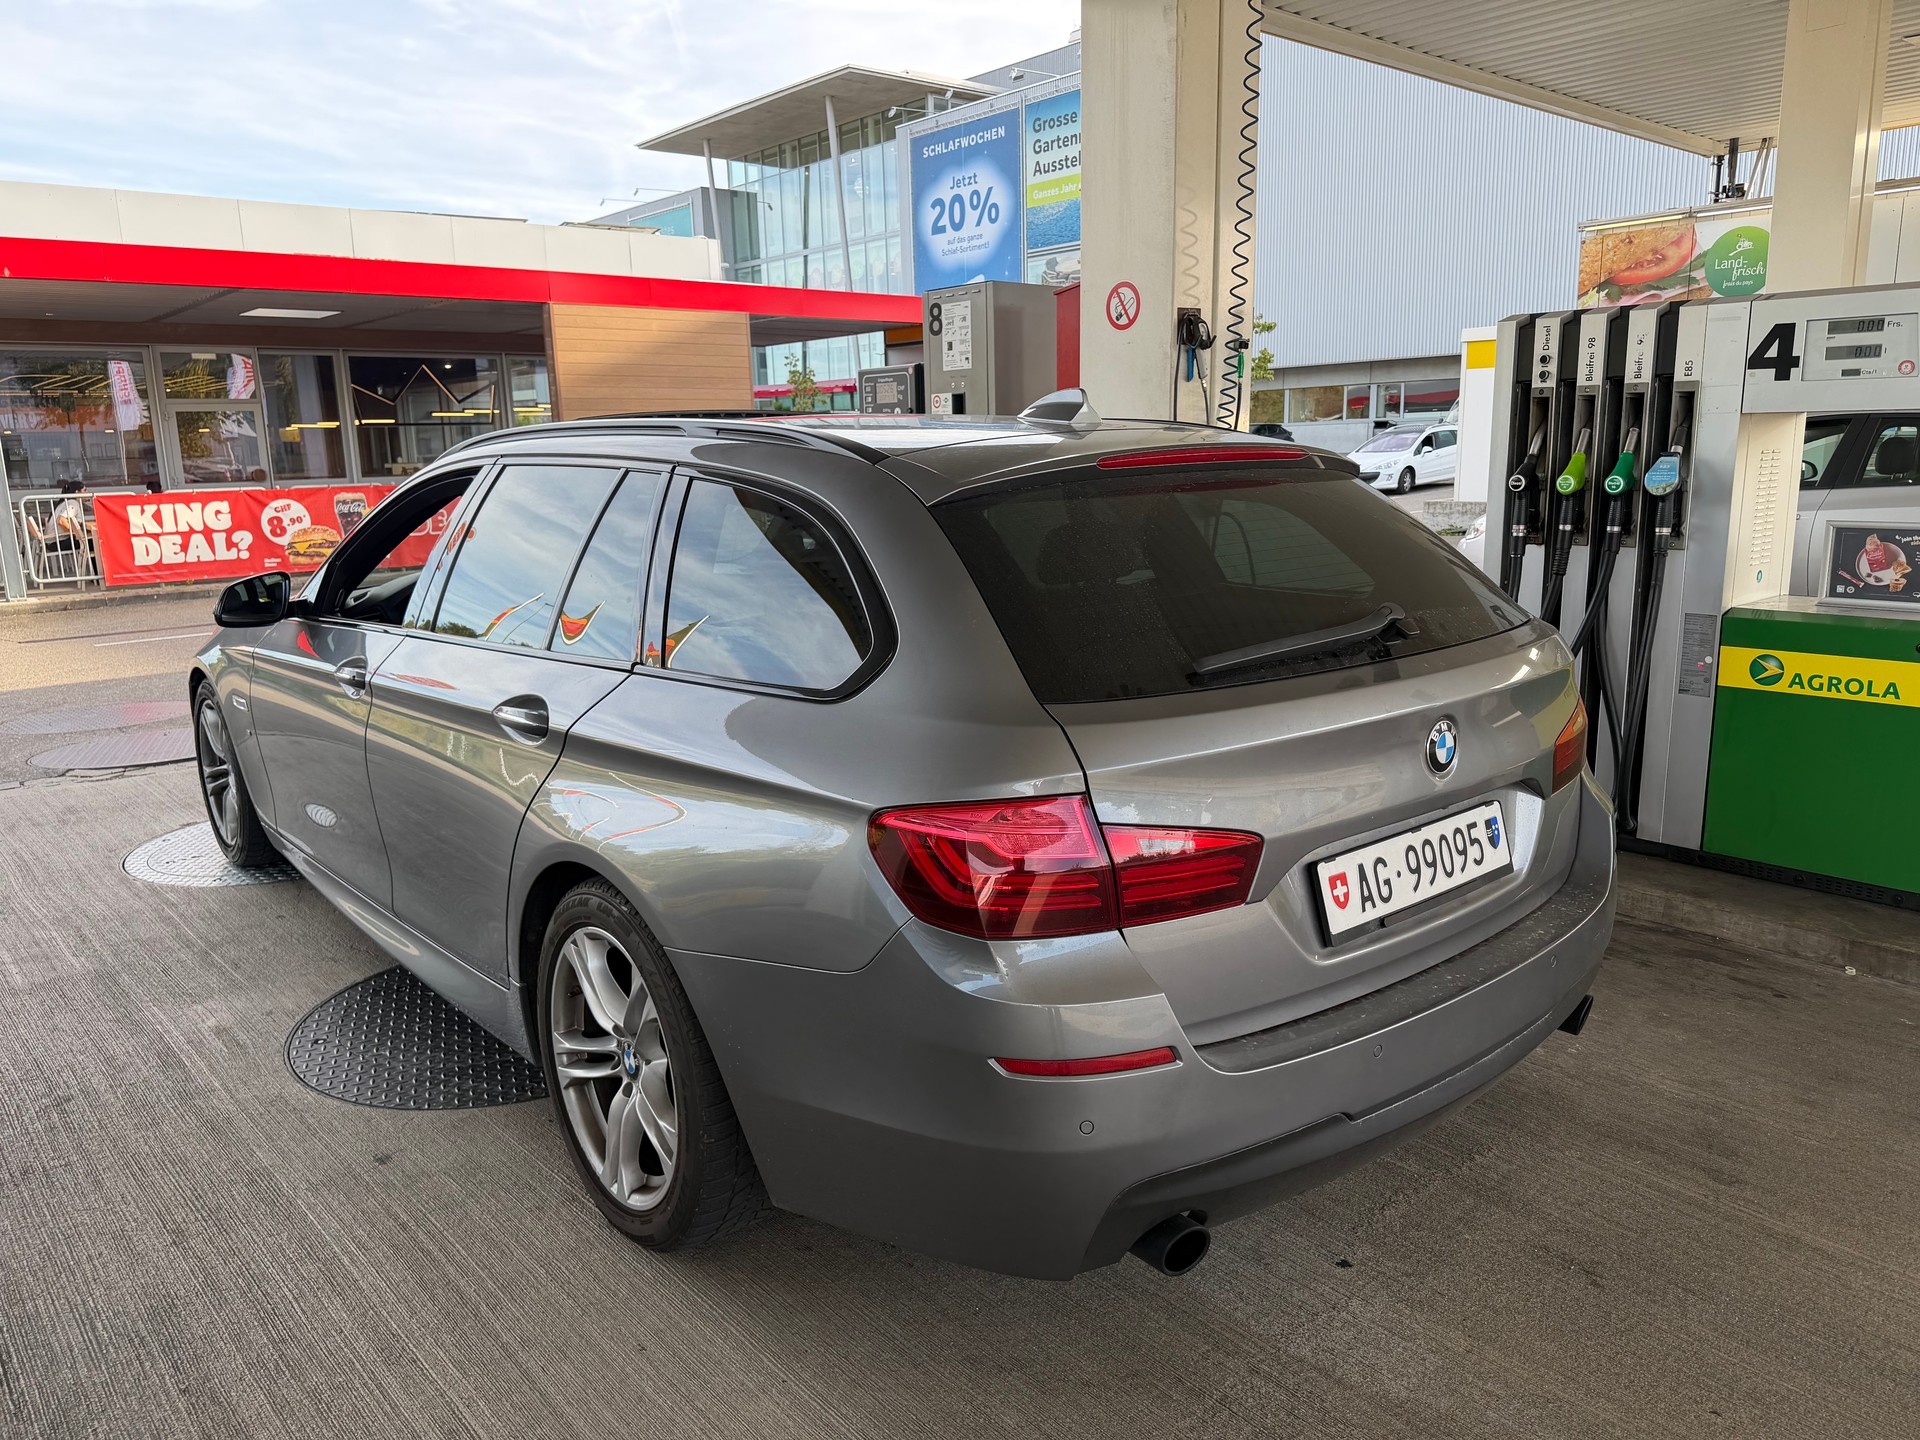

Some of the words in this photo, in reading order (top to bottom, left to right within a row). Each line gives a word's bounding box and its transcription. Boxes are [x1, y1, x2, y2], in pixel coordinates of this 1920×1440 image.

[1032, 111, 1078, 134] Grosse
[922, 125, 1005, 158] SCHLAFWOCHEN
[949, 172, 979, 190] Jetzt
[1032, 188, 1059, 200] Ganzes
[1060, 183, 1077, 194] Jahr
[930, 186, 1000, 236] 20%
[967, 233, 983, 244] ganze
[1714, 255, 1748, 270] Land-
[1732, 261, 1766, 282] frisch
[929, 302, 943, 337] 8
[1857, 319, 1885, 332] 0.00
[1887, 320, 1904, 328] Frs.
[1542, 325, 1552, 351] Diesel
[1587, 337, 1597, 349] 98
[1747, 322, 1800, 382] 4
[1854, 345, 1882, 358] 0.00
[1584, 352, 1595, 382] Bleifrei
[1683, 360, 1694, 377] E85
[126, 500, 233, 535] KING
[273, 503, 292, 514] CHF
[131, 530, 254, 567] DEAL?
[1787, 672, 1901, 700] AGROLA
[1431, 722, 1457, 742] BMW
